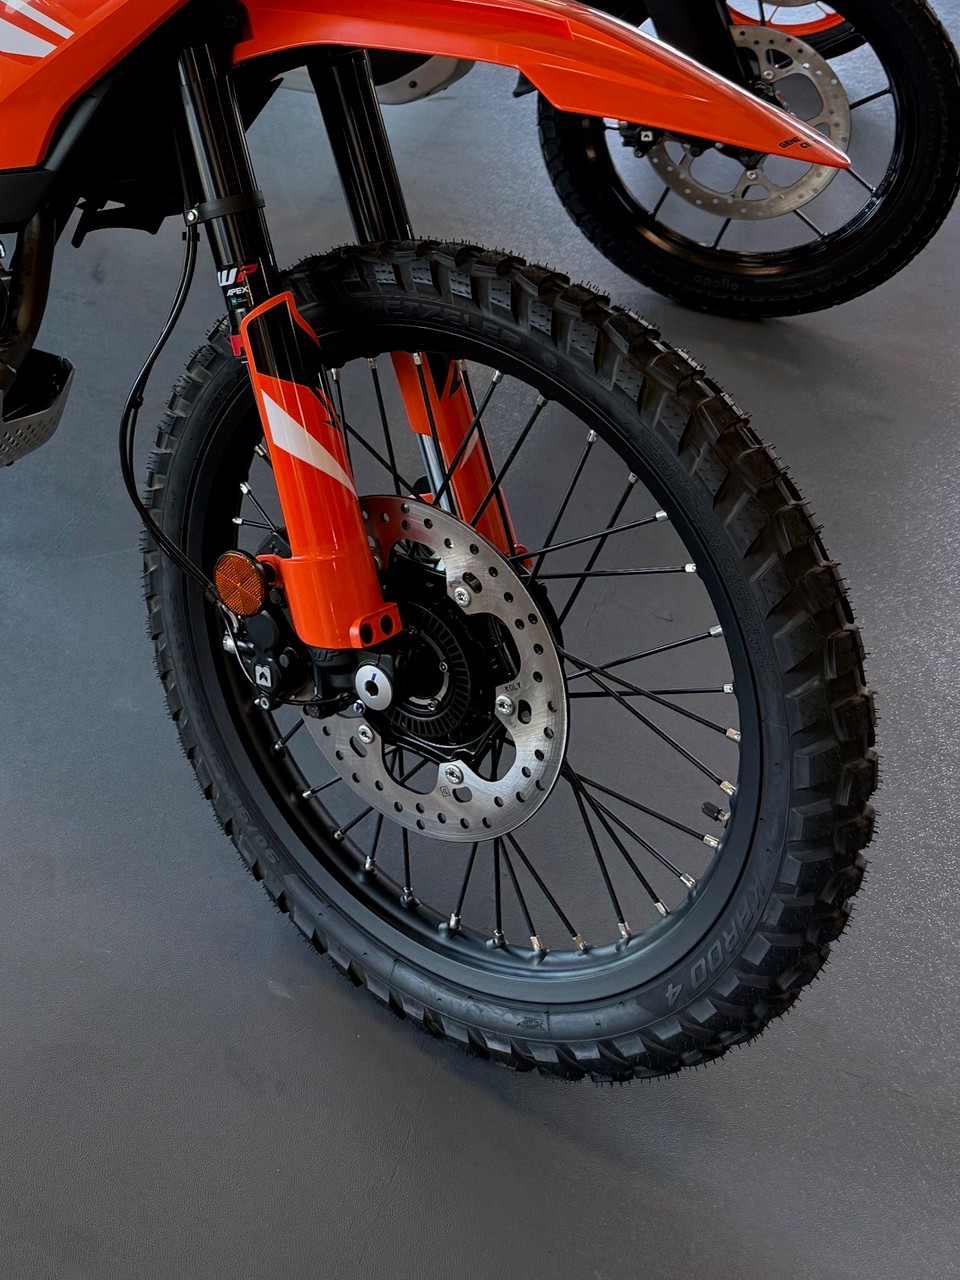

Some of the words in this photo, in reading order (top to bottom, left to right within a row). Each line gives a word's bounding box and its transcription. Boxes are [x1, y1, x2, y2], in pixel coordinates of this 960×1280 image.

[218, 263, 258, 287] WP
[226, 285, 249, 297] APEX
[665, 982, 683, 1008] 4
